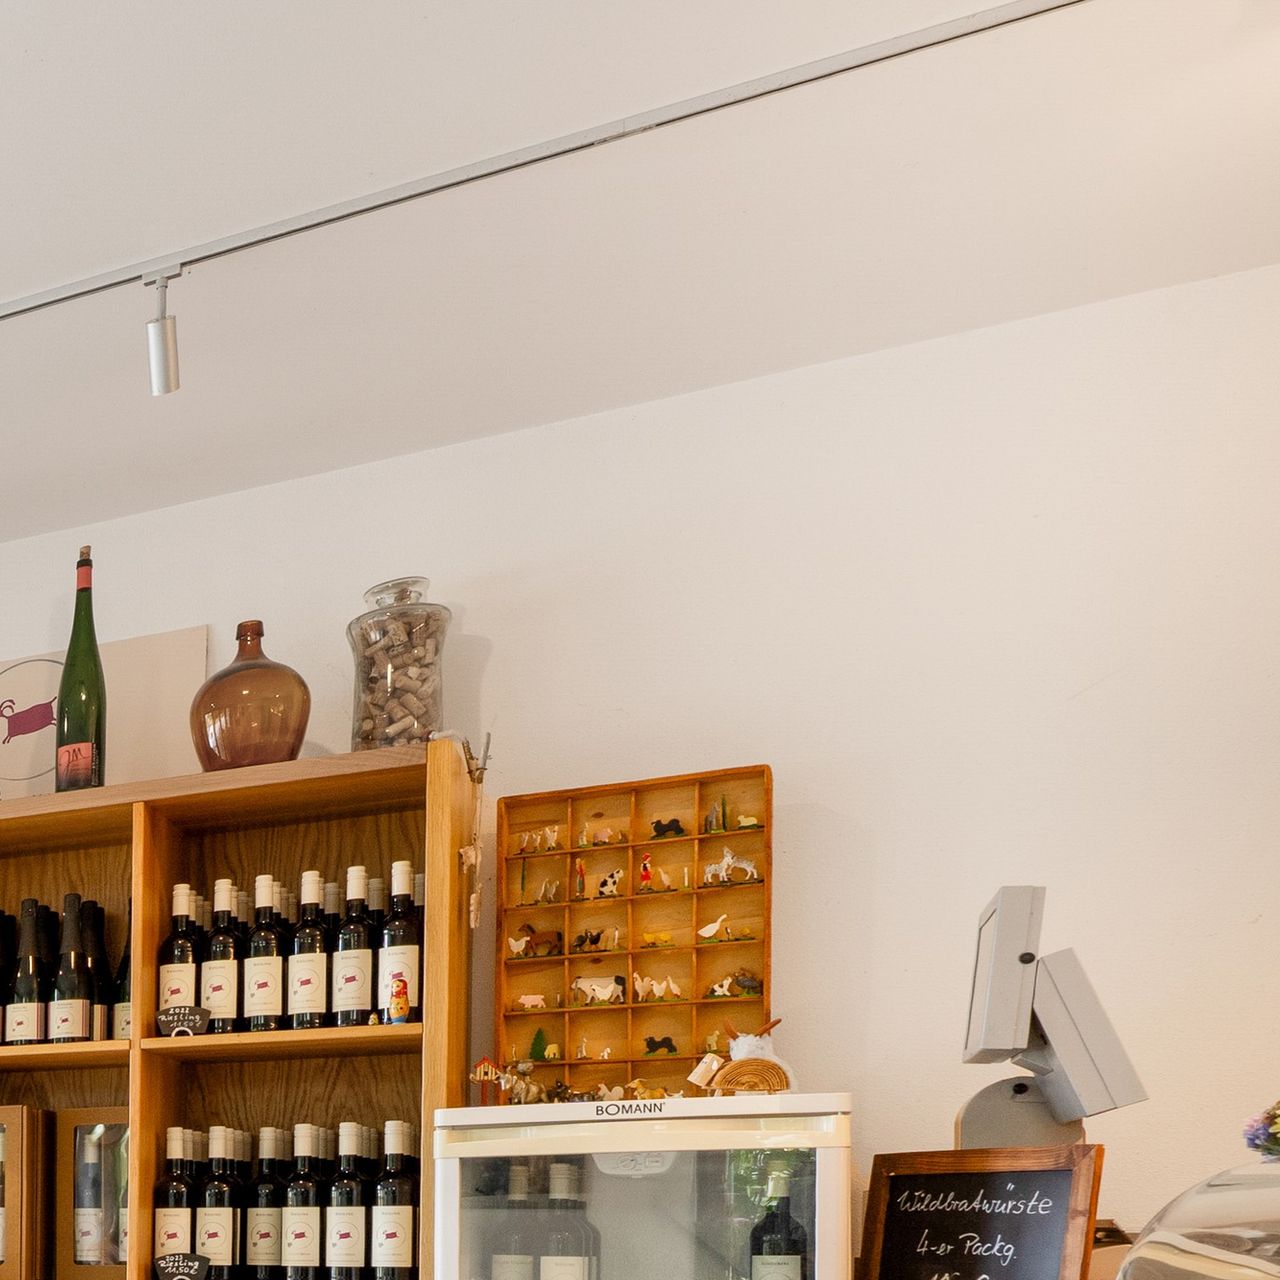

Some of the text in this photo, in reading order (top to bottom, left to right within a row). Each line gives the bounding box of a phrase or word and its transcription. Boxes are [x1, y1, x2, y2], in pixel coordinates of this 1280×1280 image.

[158, 1013, 201, 1023] Riesling
[596, 1102, 663, 1116] BOMANN
[897, 1182, 1053, 1215] Wildbratwürste
[916, 1229, 1017, 1266] 4-er Packg.
[158, 1259, 200, 1269] Riesling
[165, 1266, 198, 1275] 11,50€
